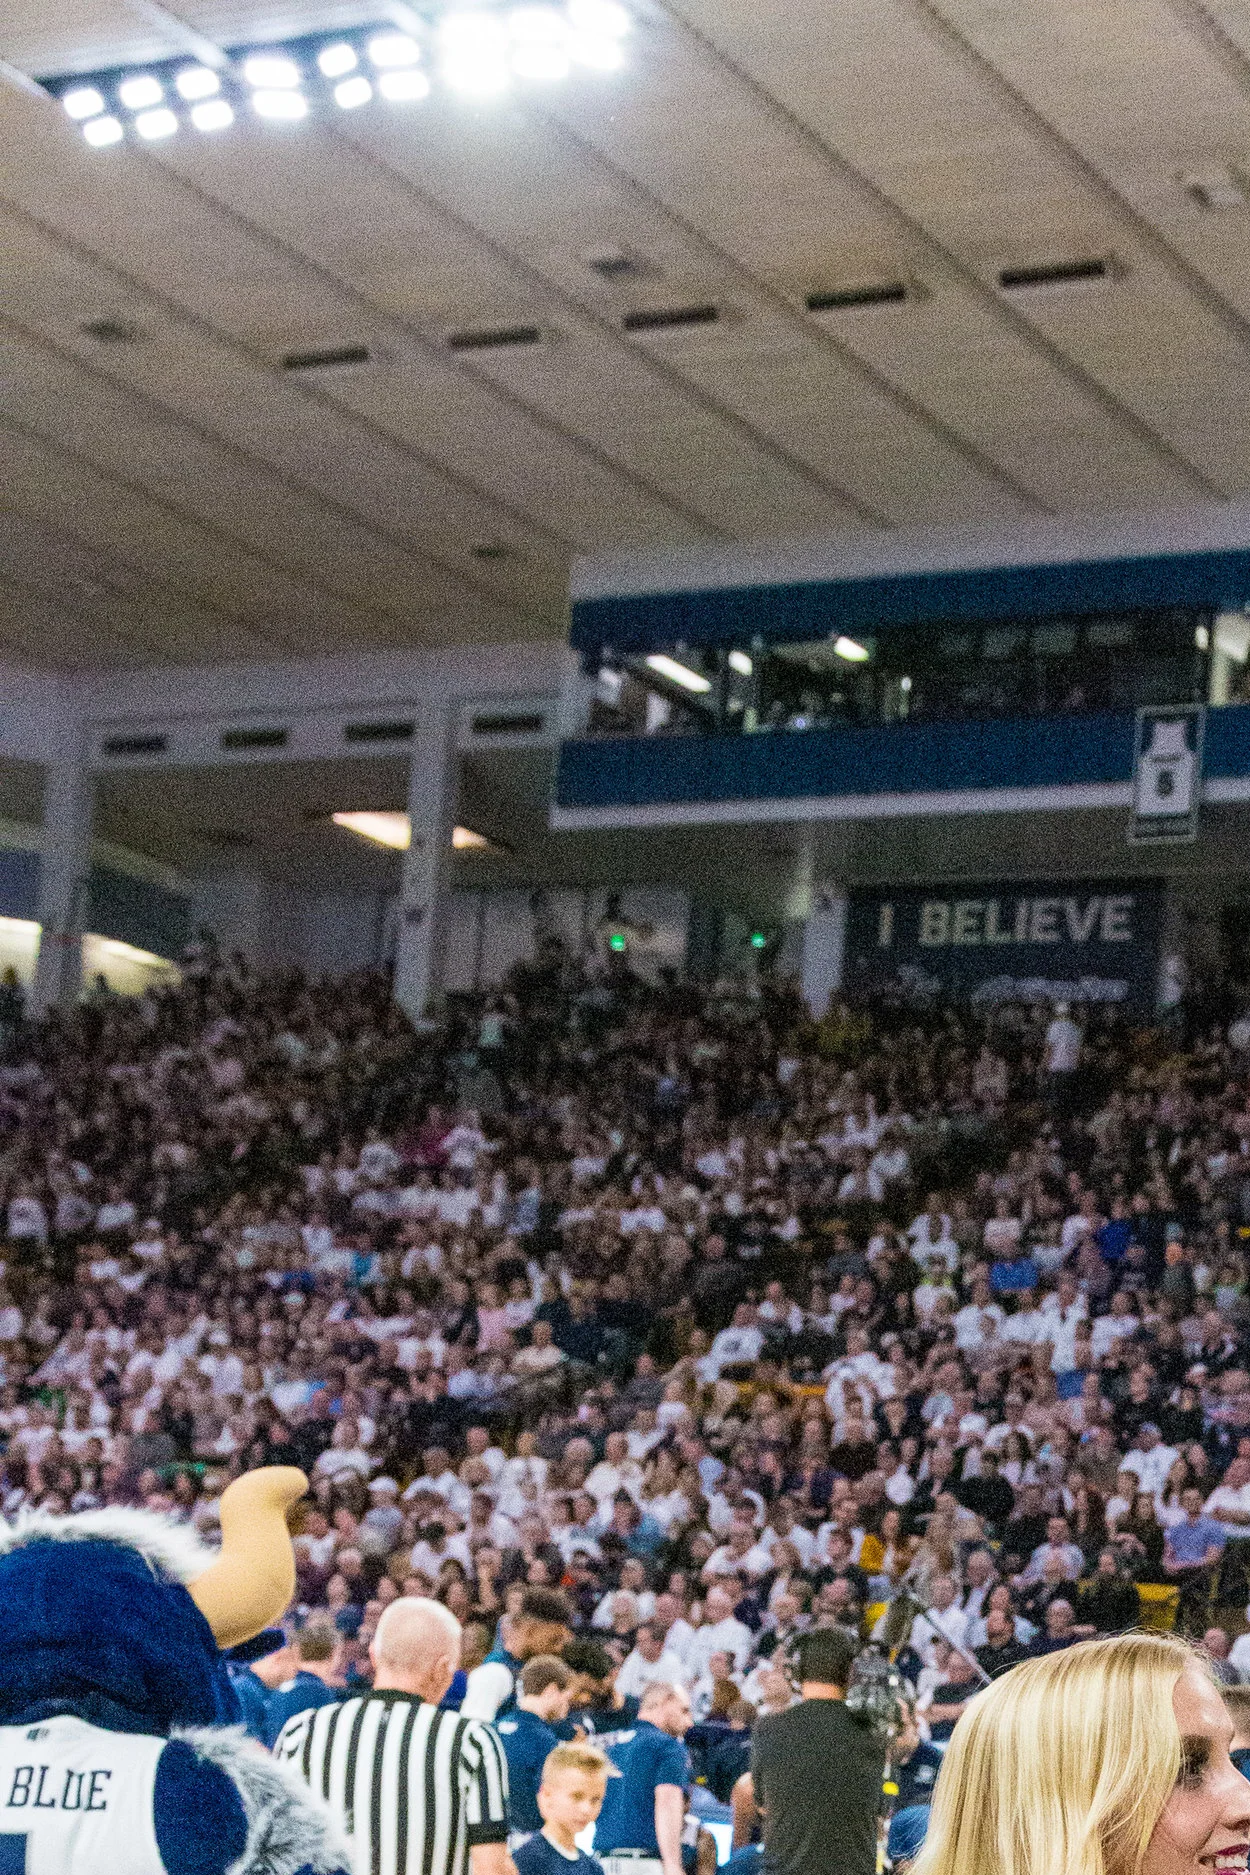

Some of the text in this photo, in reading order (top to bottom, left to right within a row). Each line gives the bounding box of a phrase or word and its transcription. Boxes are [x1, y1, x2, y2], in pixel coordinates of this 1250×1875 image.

[877, 894, 1136, 948] I BELIEVE
[6, 1765, 112, 1813] BLUE
